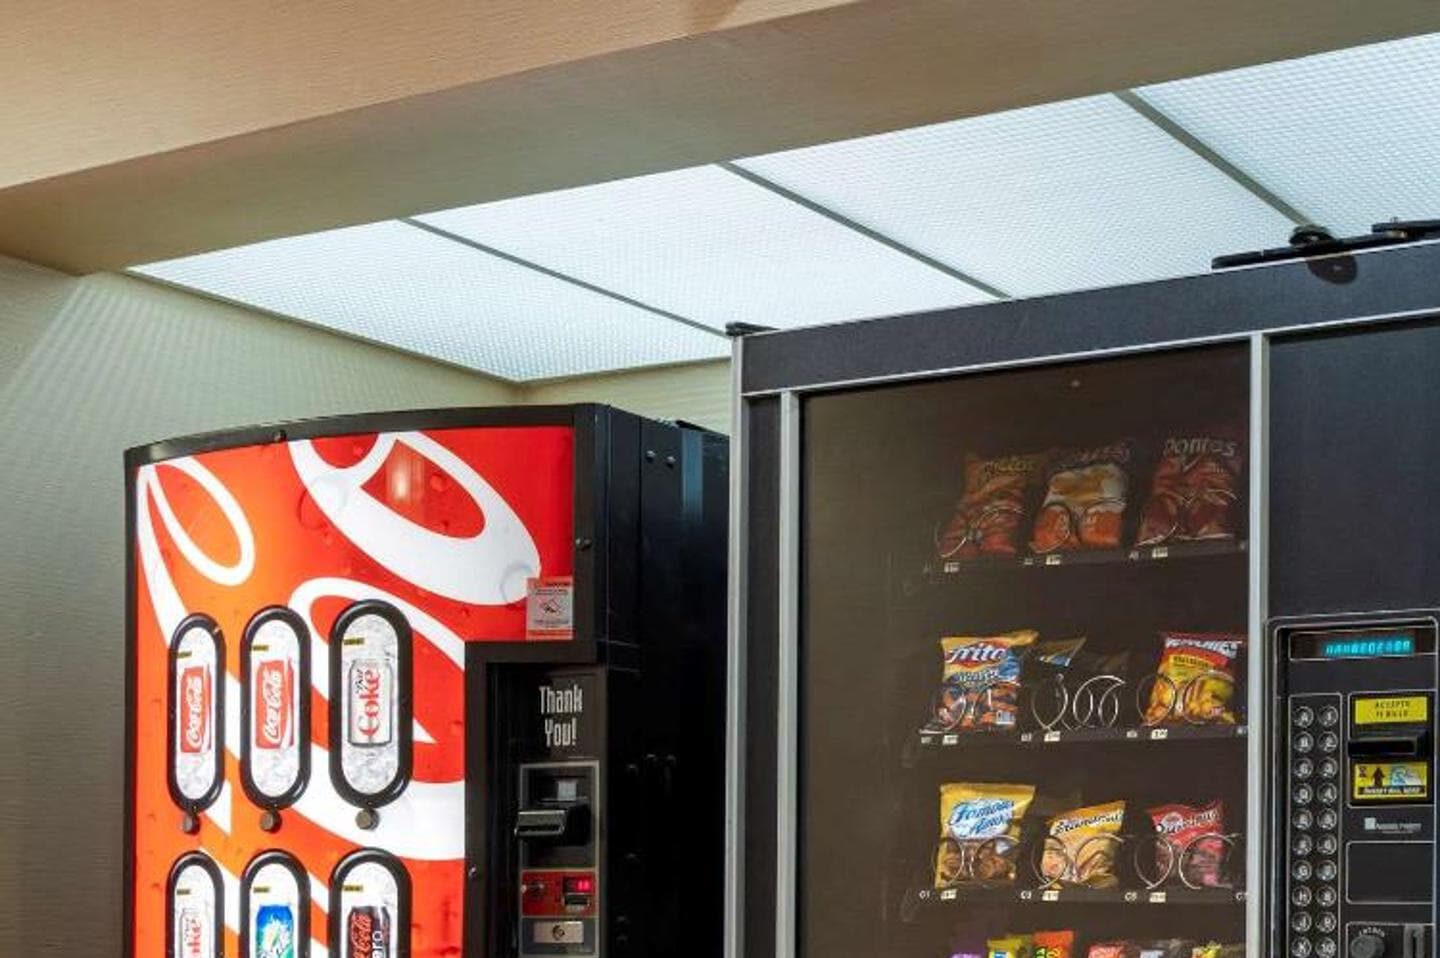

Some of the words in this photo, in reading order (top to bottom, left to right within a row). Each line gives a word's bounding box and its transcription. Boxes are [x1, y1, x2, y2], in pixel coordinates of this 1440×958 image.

[359, 670, 381, 737] Coke
[539, 684, 583, 714] Thank
[544, 717, 577, 747] You!
